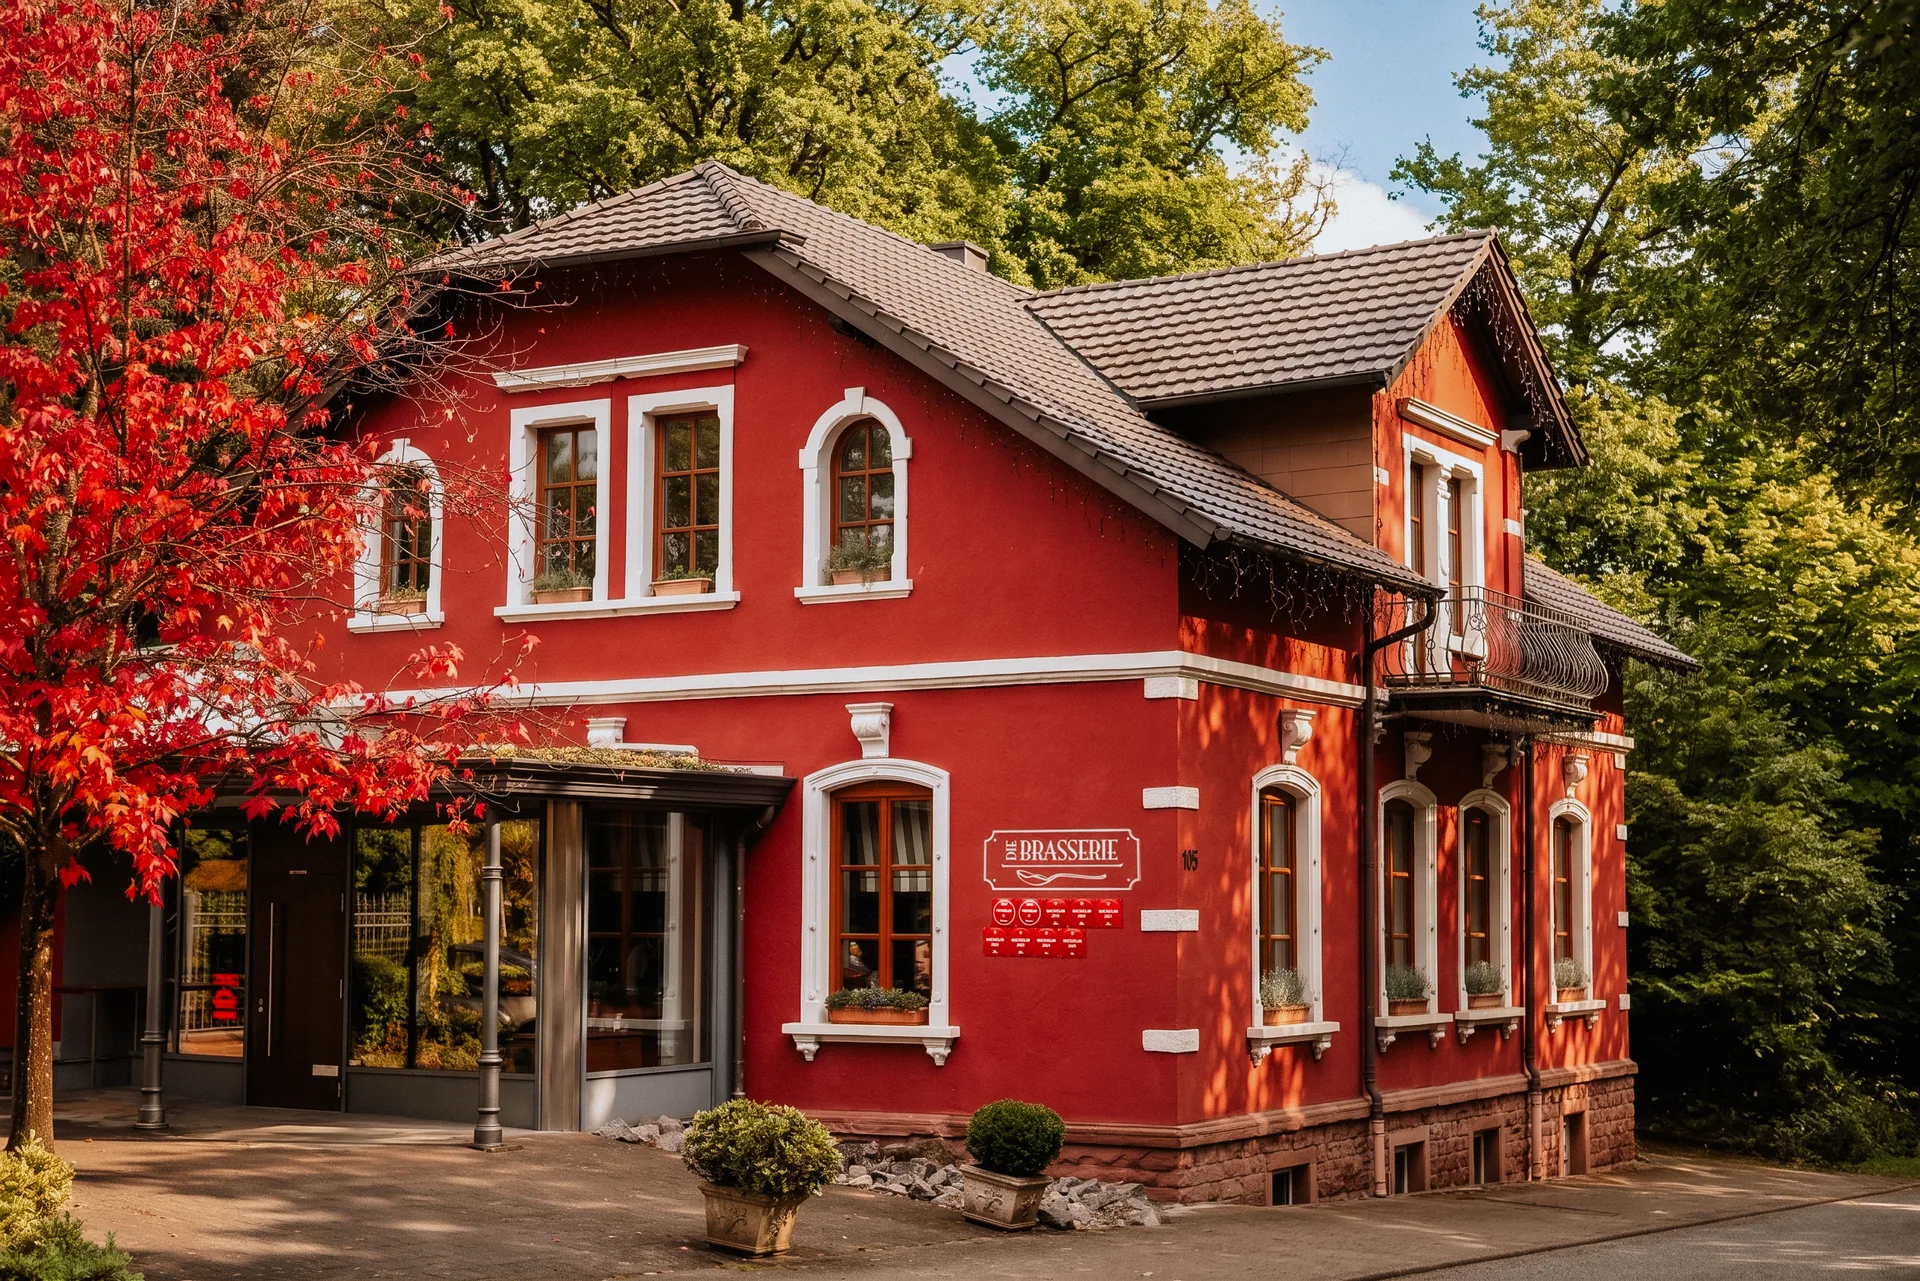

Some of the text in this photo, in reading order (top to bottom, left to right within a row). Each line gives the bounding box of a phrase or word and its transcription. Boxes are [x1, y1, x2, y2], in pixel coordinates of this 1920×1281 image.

[1005, 839, 1119, 861] DIE BRASSERIE
[1181, 849, 1199, 872] 105
